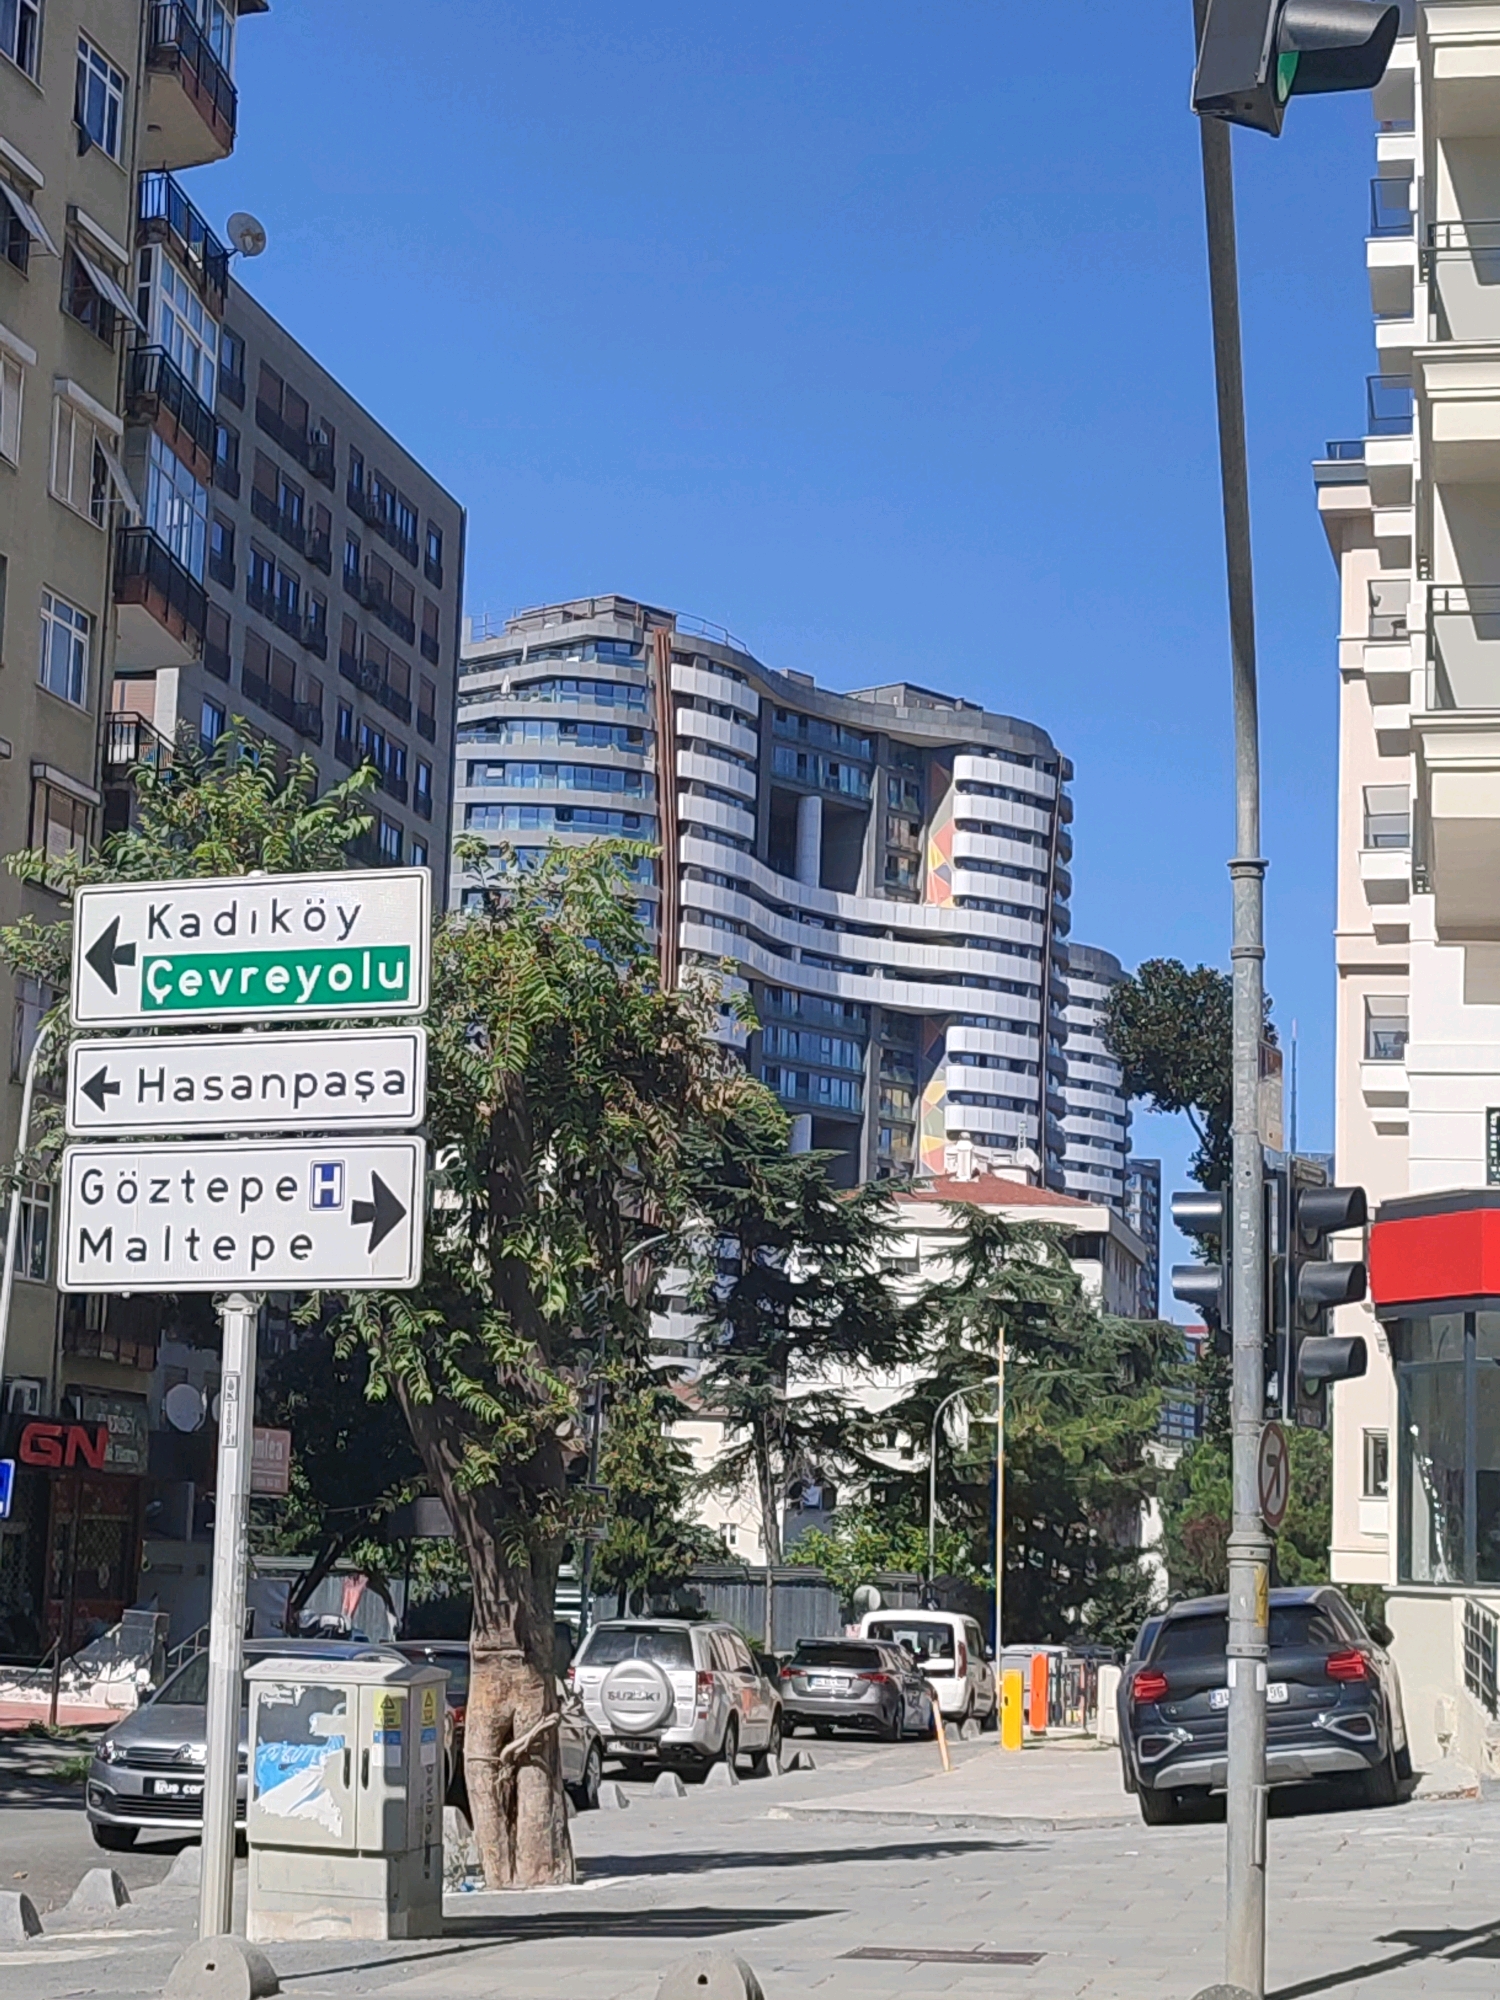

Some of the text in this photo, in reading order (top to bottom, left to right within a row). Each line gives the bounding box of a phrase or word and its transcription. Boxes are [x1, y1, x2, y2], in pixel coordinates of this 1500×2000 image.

[146, 898, 362, 941] Kadıköy
[145, 951, 406, 1004] Çevreyolu
[137, 1066, 407, 1109] Hasanpaşa
[80, 1165, 342, 1214] Göztepe H
[79, 1225, 314, 1272] Maltepe
[19, 1422, 109, 1469] GN
[607, 1690, 661, 1702] SUZUKI
